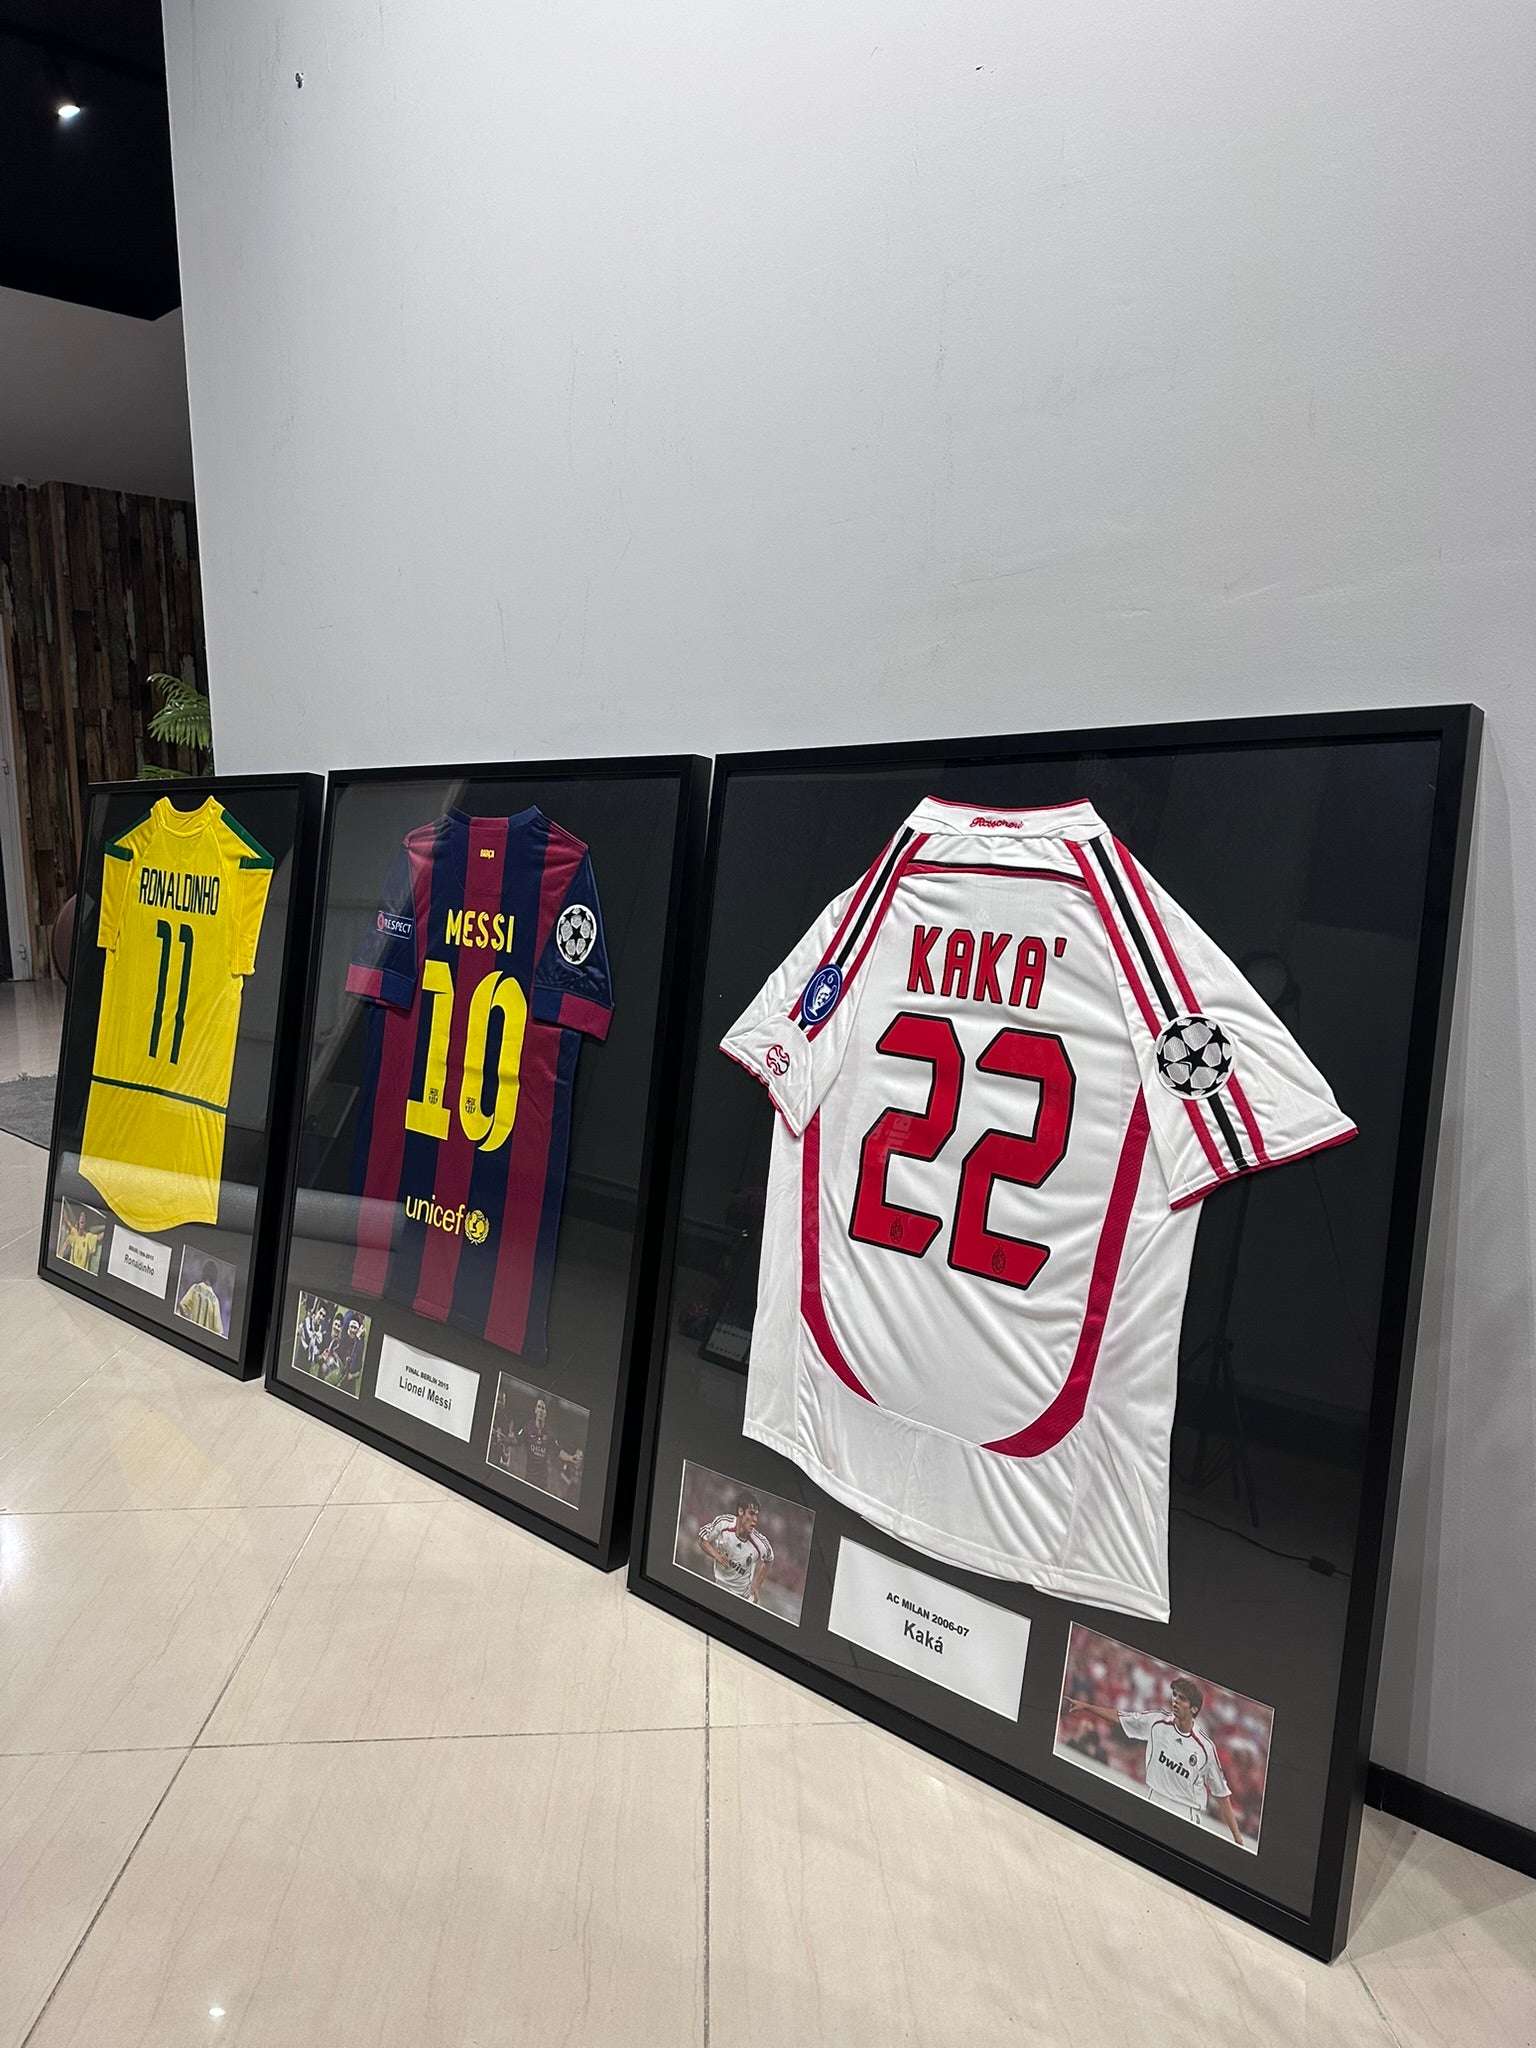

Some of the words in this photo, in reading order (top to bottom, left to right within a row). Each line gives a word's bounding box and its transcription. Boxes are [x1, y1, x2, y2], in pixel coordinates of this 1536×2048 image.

[138, 867, 220, 916] RONALDINHO
[384, 918, 412, 933] RESPECT
[445, 908, 515, 953] MESSI
[148, 919, 194, 1065] 11
[828, 973, 835, 984] 6
[405, 960, 528, 1151] 10
[848, 1011, 1077, 1290] 22
[405, 1195, 466, 1235] unicef
[399, 1376, 426, 1398] Lionel
[427, 1388, 452, 1411] Messi
[405, 1365, 420, 1377] FINAL
[420, 1371, 438, 1385] BERLIN
[437, 1380, 450, 1391] 2015
[886, 1592, 900, 1605] AC
[901, 1598, 930, 1620] MILAN
[931, 1613, 970, 1637] 2006-07
[903, 1619, 944, 1655] Kaká
[1158, 1751, 1191, 1780] bwin
